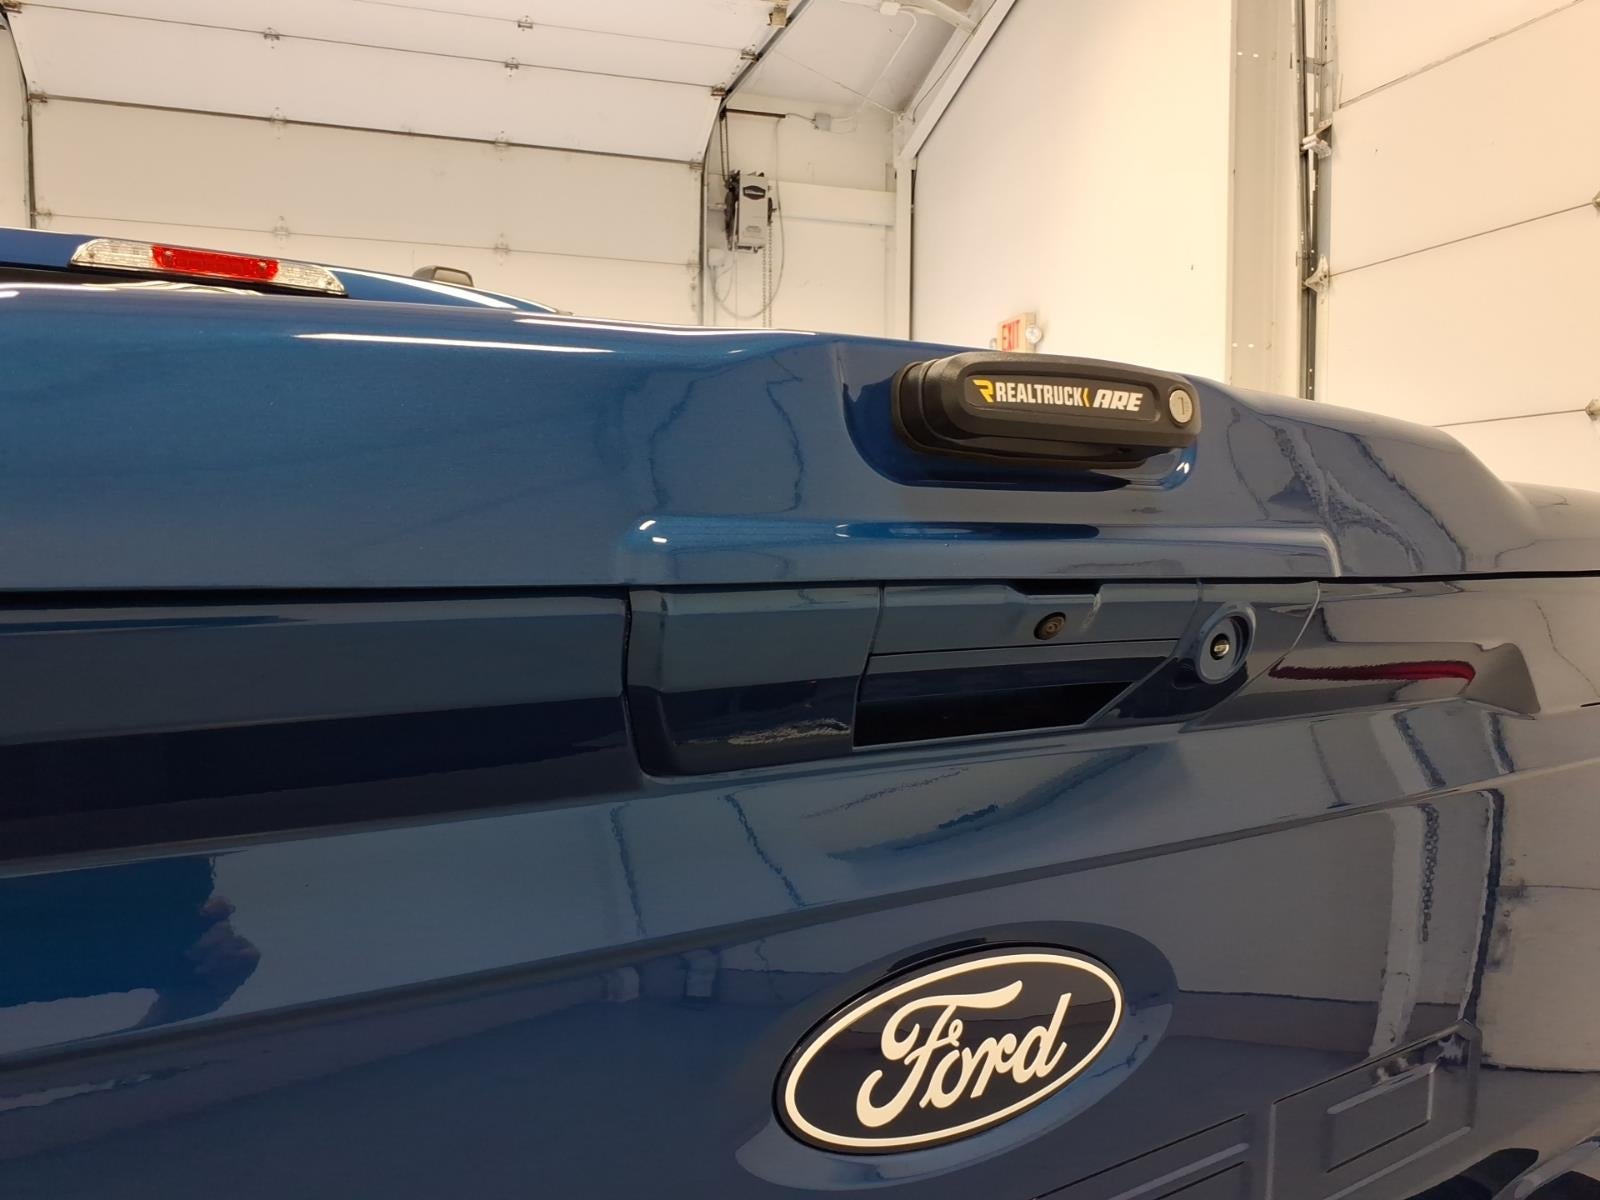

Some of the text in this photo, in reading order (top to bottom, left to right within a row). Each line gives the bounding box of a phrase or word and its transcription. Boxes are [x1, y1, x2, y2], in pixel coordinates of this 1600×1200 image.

[1002, 320, 1020, 352] EXIT
[995, 382, 1083, 407] REALTRUCK
[1093, 389, 1143, 412] ARE
[856, 980, 1071, 1127] Ford
